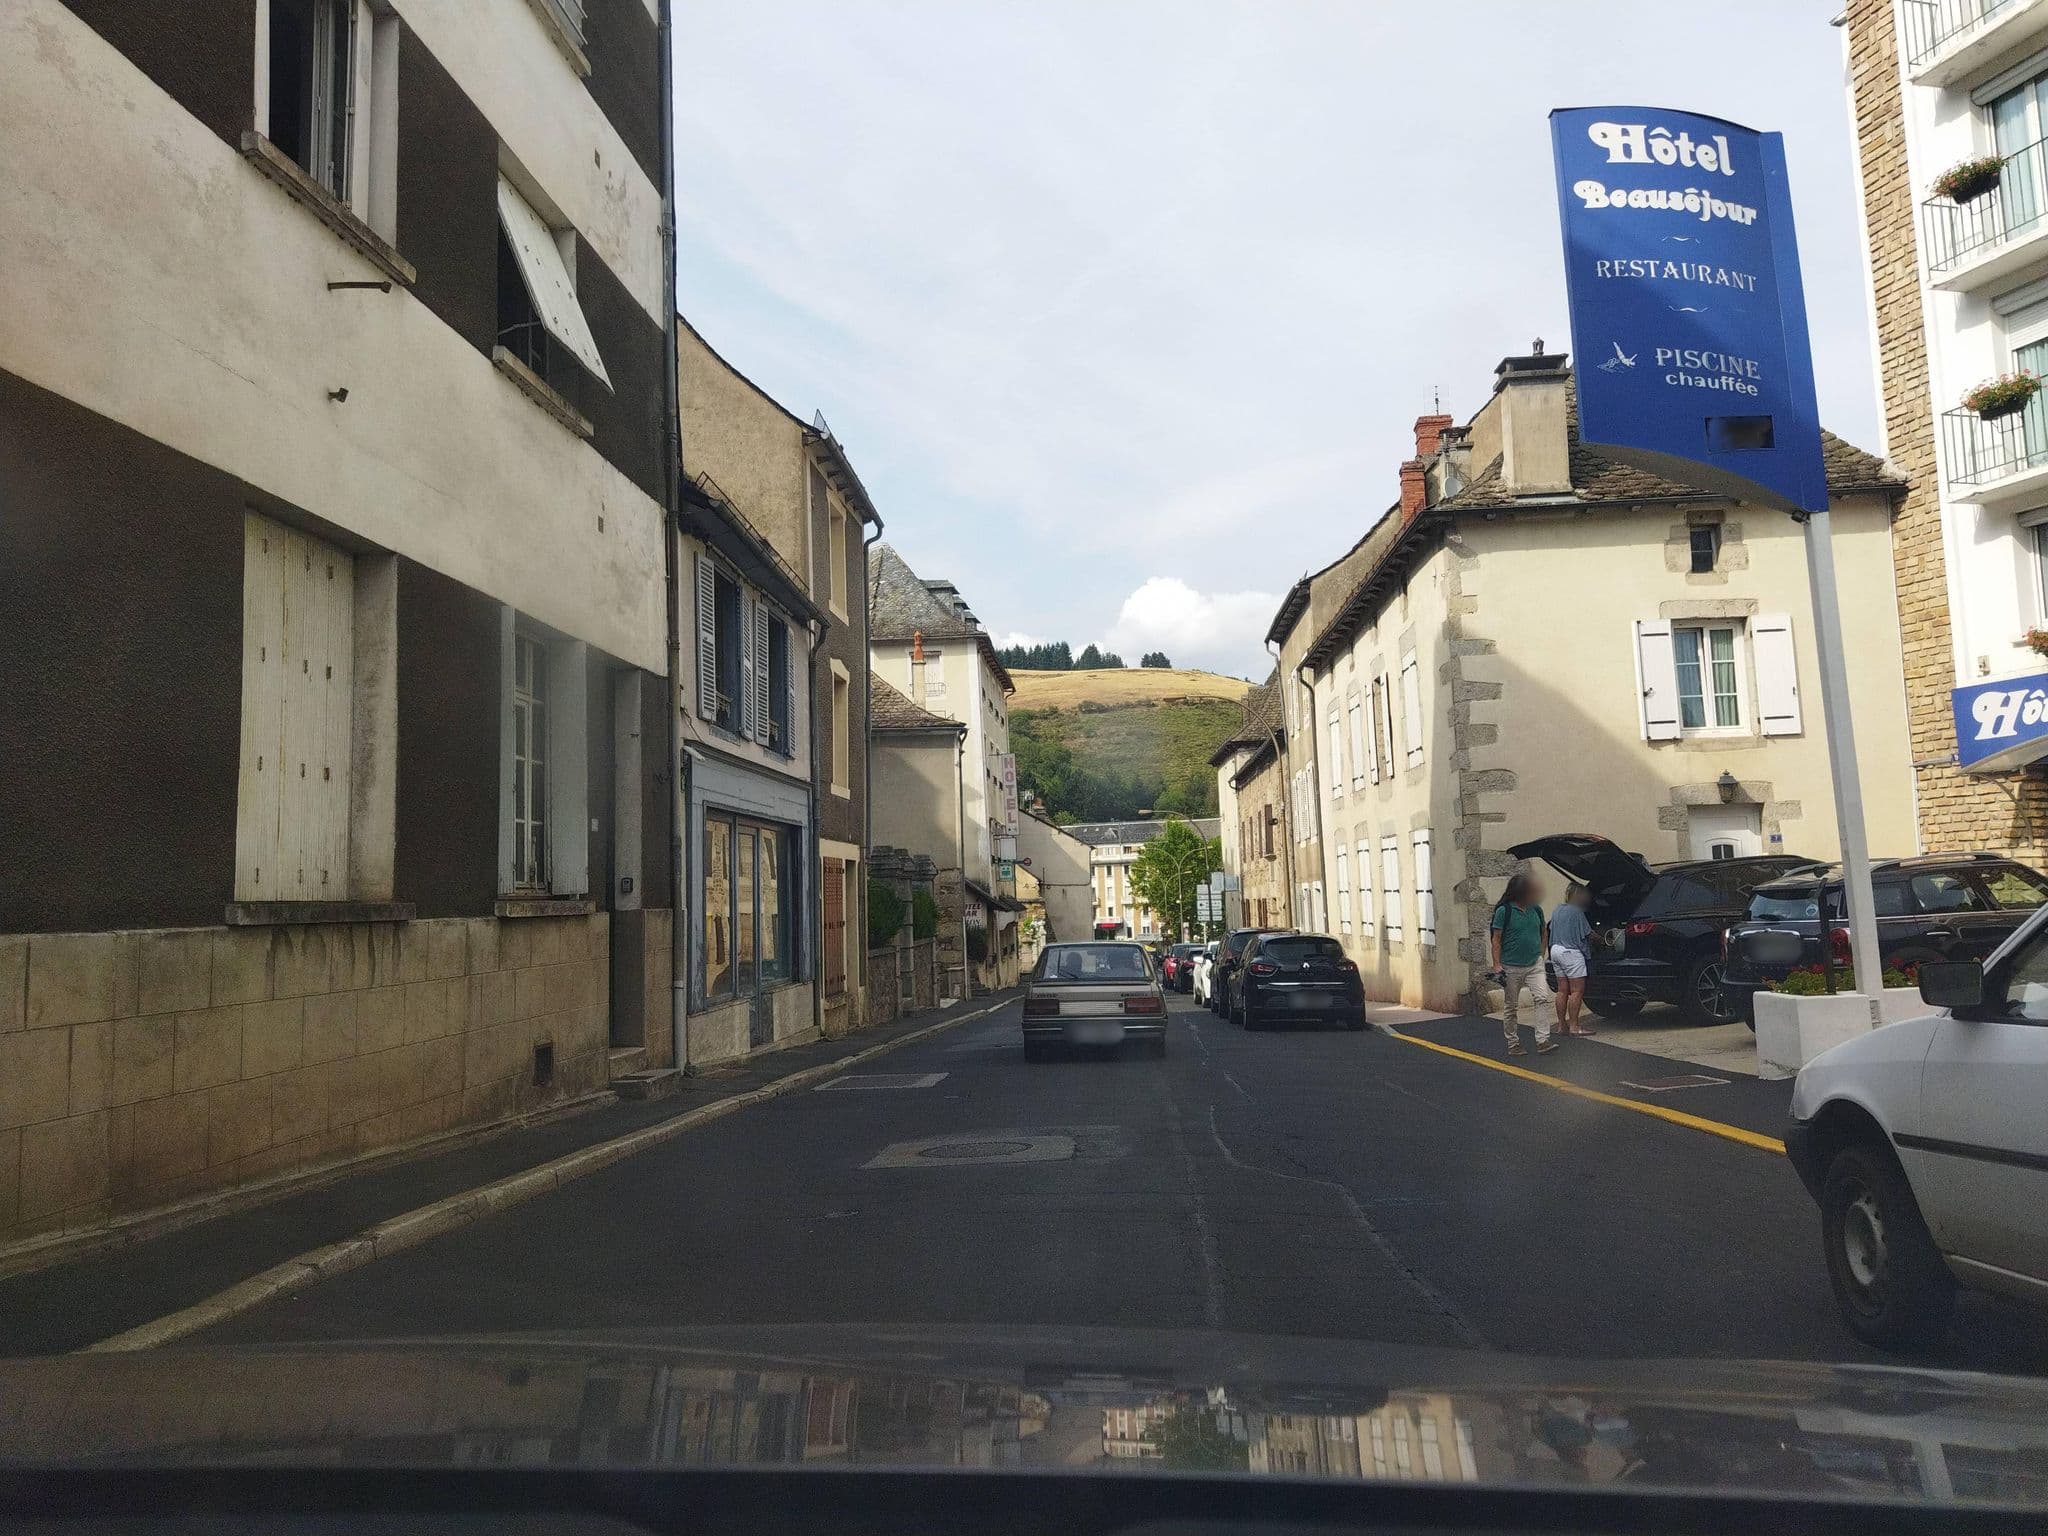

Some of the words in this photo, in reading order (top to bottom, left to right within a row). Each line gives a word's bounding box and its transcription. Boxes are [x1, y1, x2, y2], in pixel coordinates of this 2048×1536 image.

[1588, 122, 1735, 176] Hôtel
[1597, 260, 1757, 292] RESTAURANT
[1655, 348, 1761, 380] PISCINE
[1665, 371, 1759, 396] chauffée
[1003, 757, 1017, 824] HOTEL
